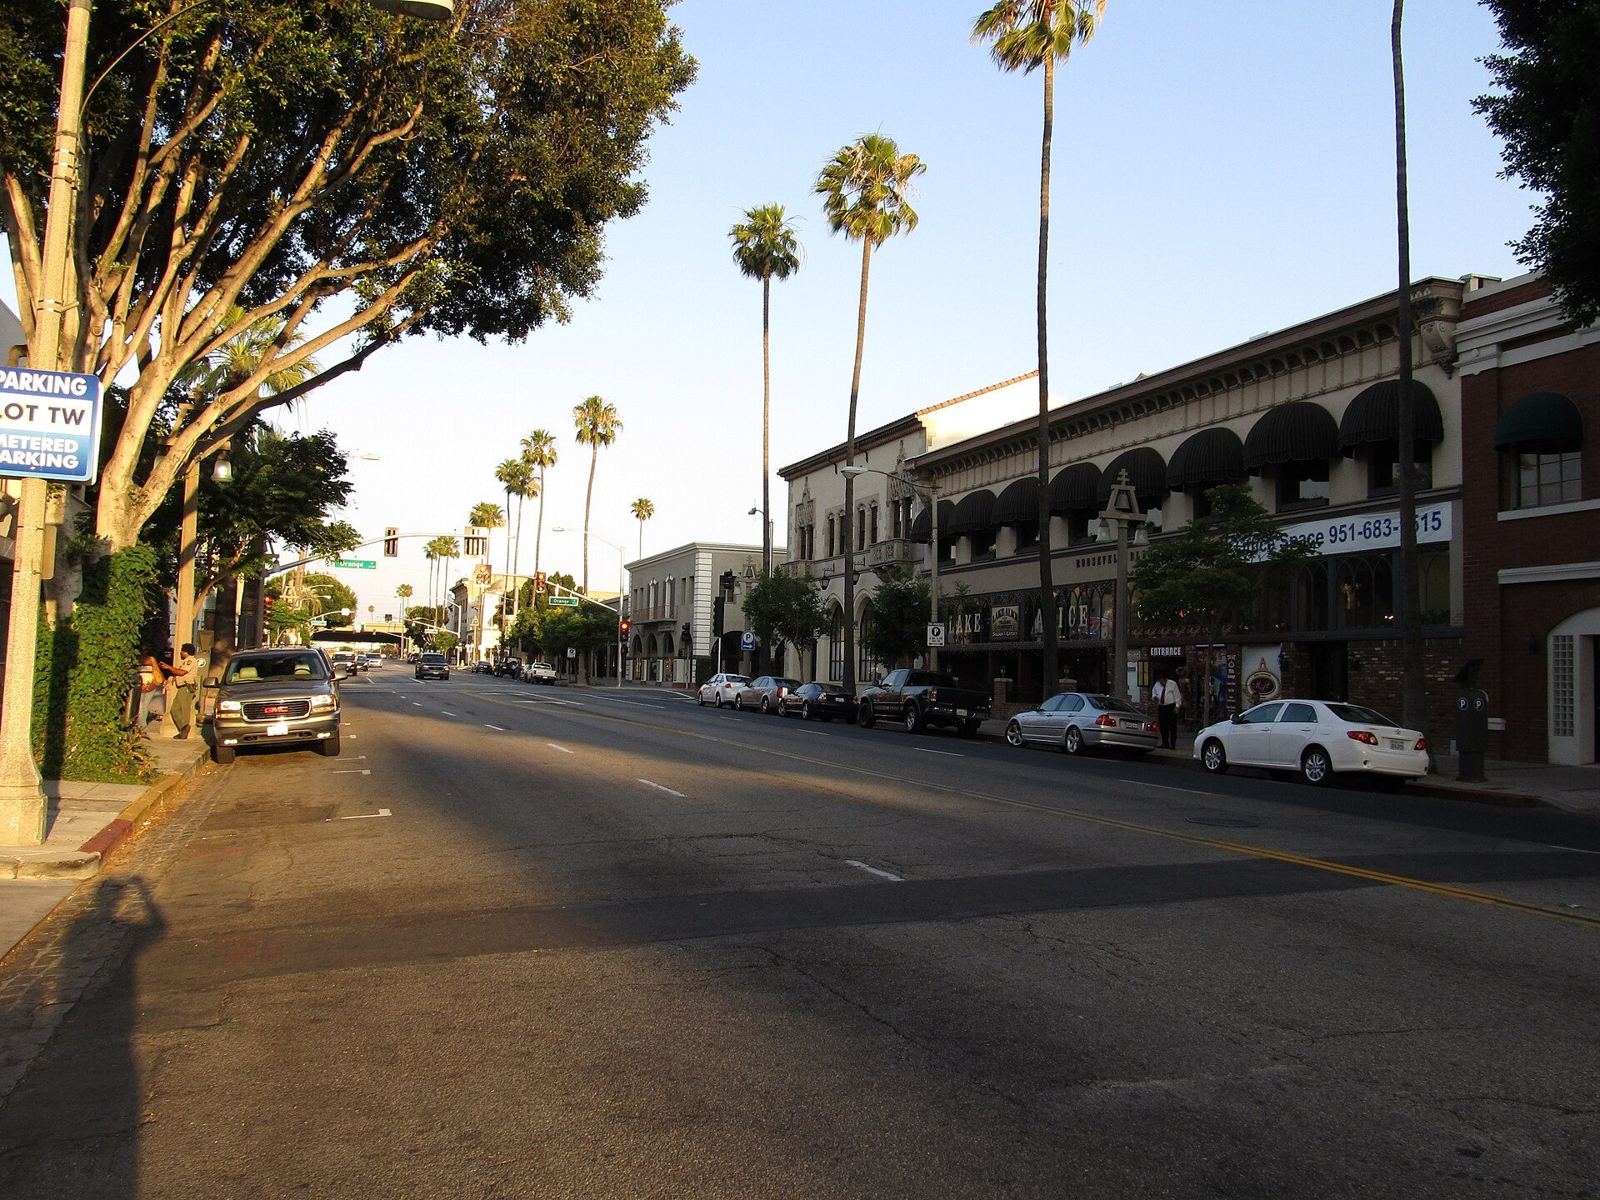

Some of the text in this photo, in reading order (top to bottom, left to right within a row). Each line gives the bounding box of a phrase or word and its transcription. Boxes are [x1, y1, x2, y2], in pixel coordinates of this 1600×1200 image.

[0, 402, 85, 426] OT TW
[0, 449, 79, 470] ARKING
[1329, 511, 1442, 544] 951-683-15
[948, 613, 981, 634] LAKE
[1032, 605, 1088, 634] AICE
[1150, 647, 1181, 656] ENTRANCE
